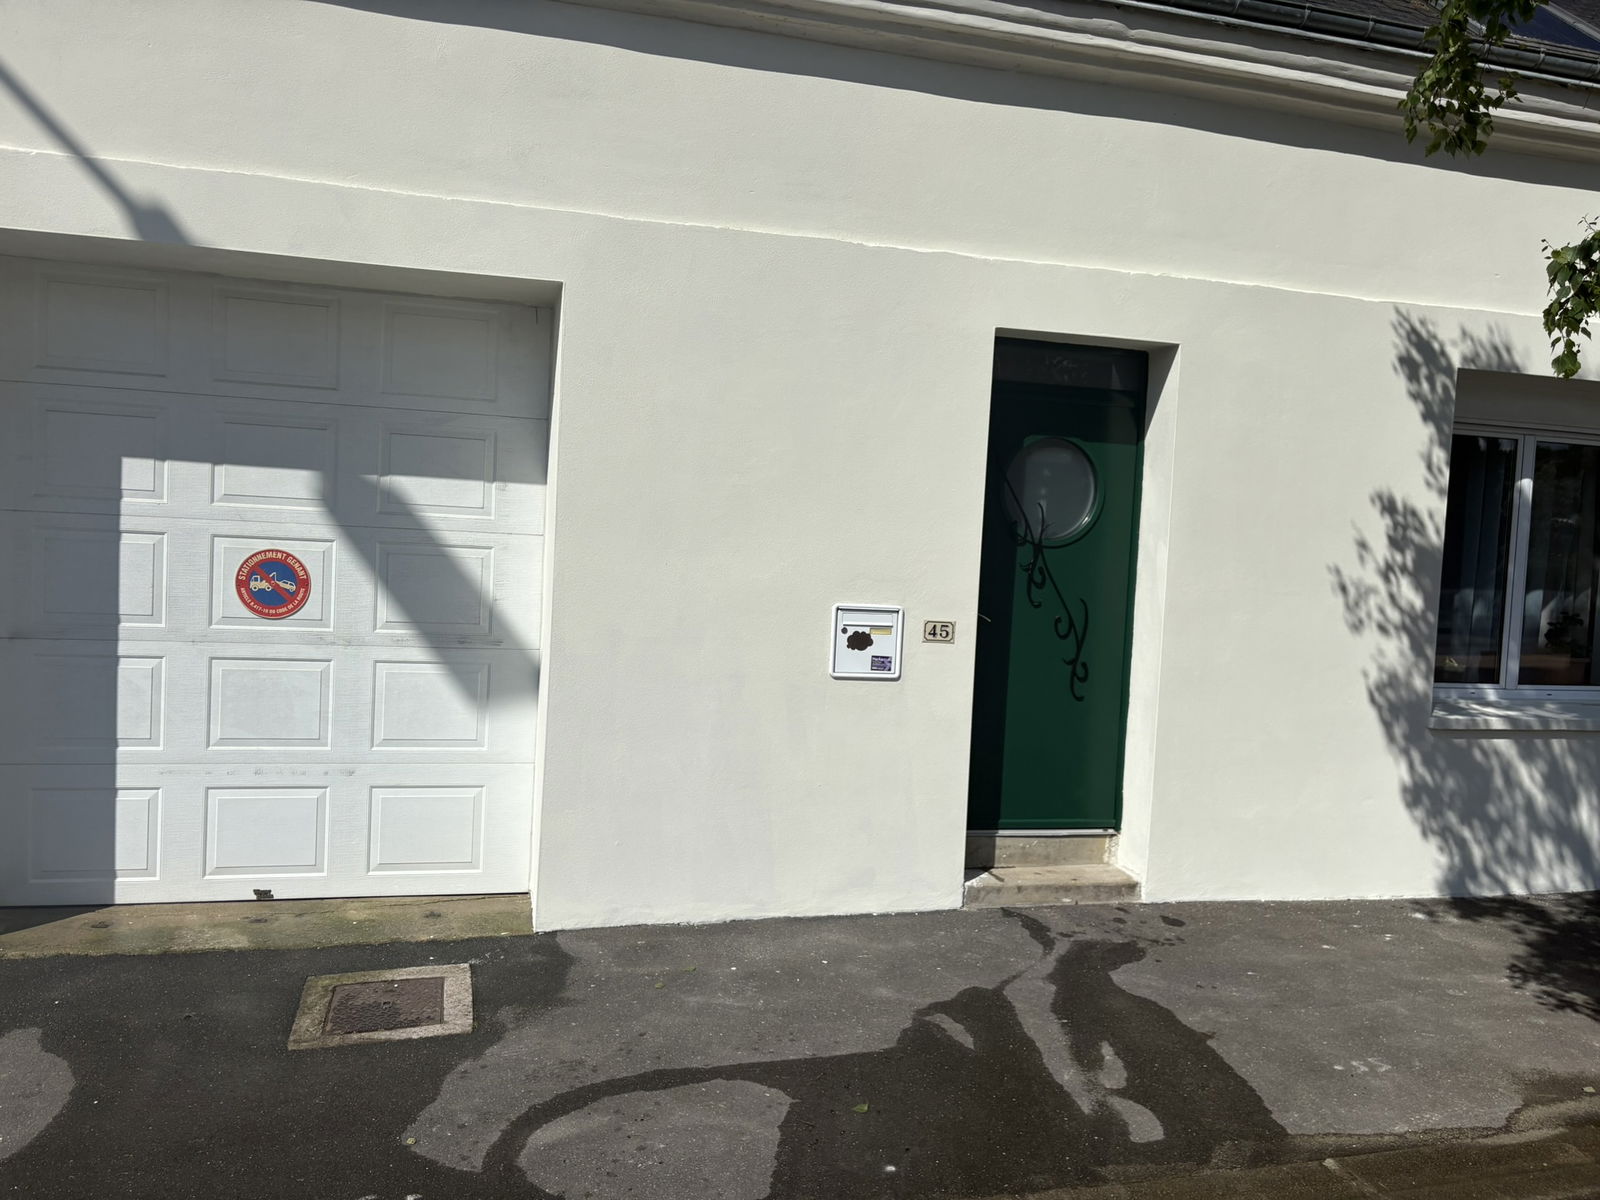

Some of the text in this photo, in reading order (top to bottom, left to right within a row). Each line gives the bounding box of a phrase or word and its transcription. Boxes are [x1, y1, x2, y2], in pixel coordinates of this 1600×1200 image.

[239, 551, 307, 580] STATIONNEMENT GENANT
[928, 624, 950, 639] 45
